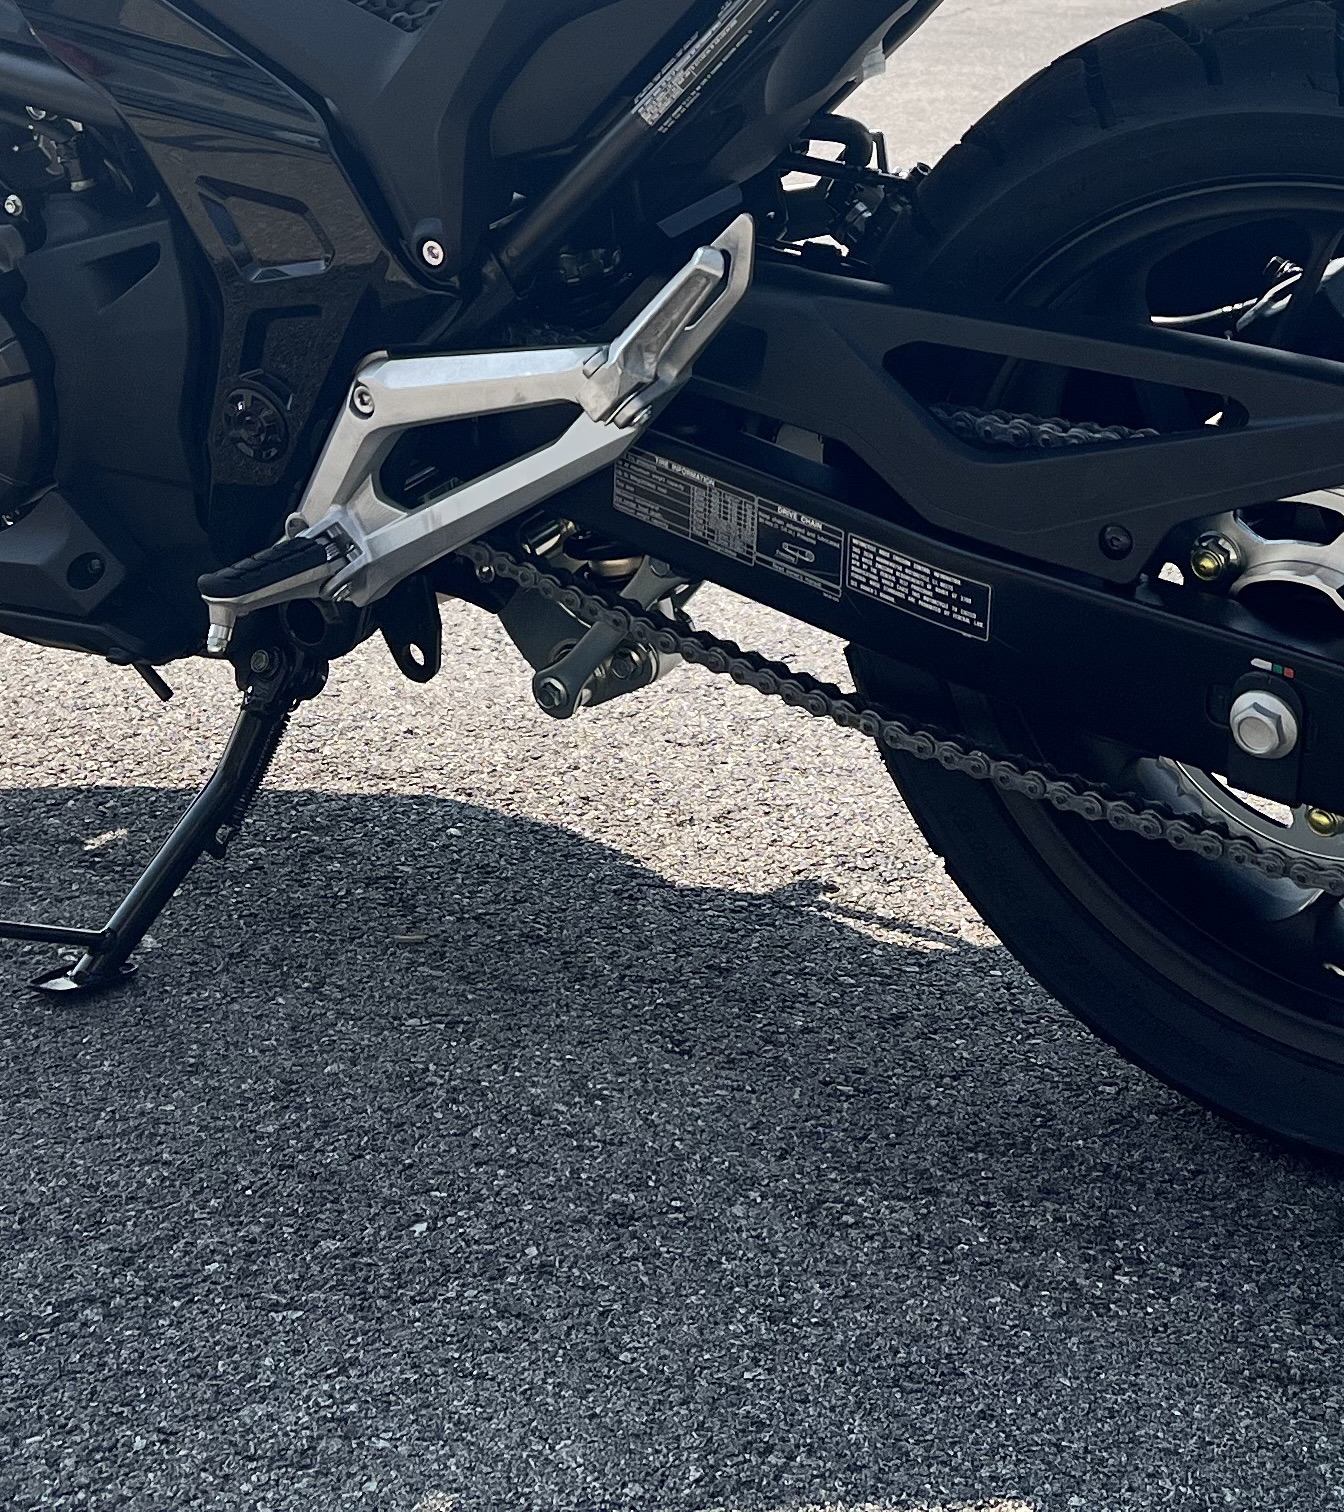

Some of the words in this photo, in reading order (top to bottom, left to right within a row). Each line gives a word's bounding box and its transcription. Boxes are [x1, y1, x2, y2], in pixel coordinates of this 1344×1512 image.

[671, 462, 716, 487] INFORMATION
[777, 505, 798, 522] DRIVE
[800, 515, 823, 531] CHAIN
